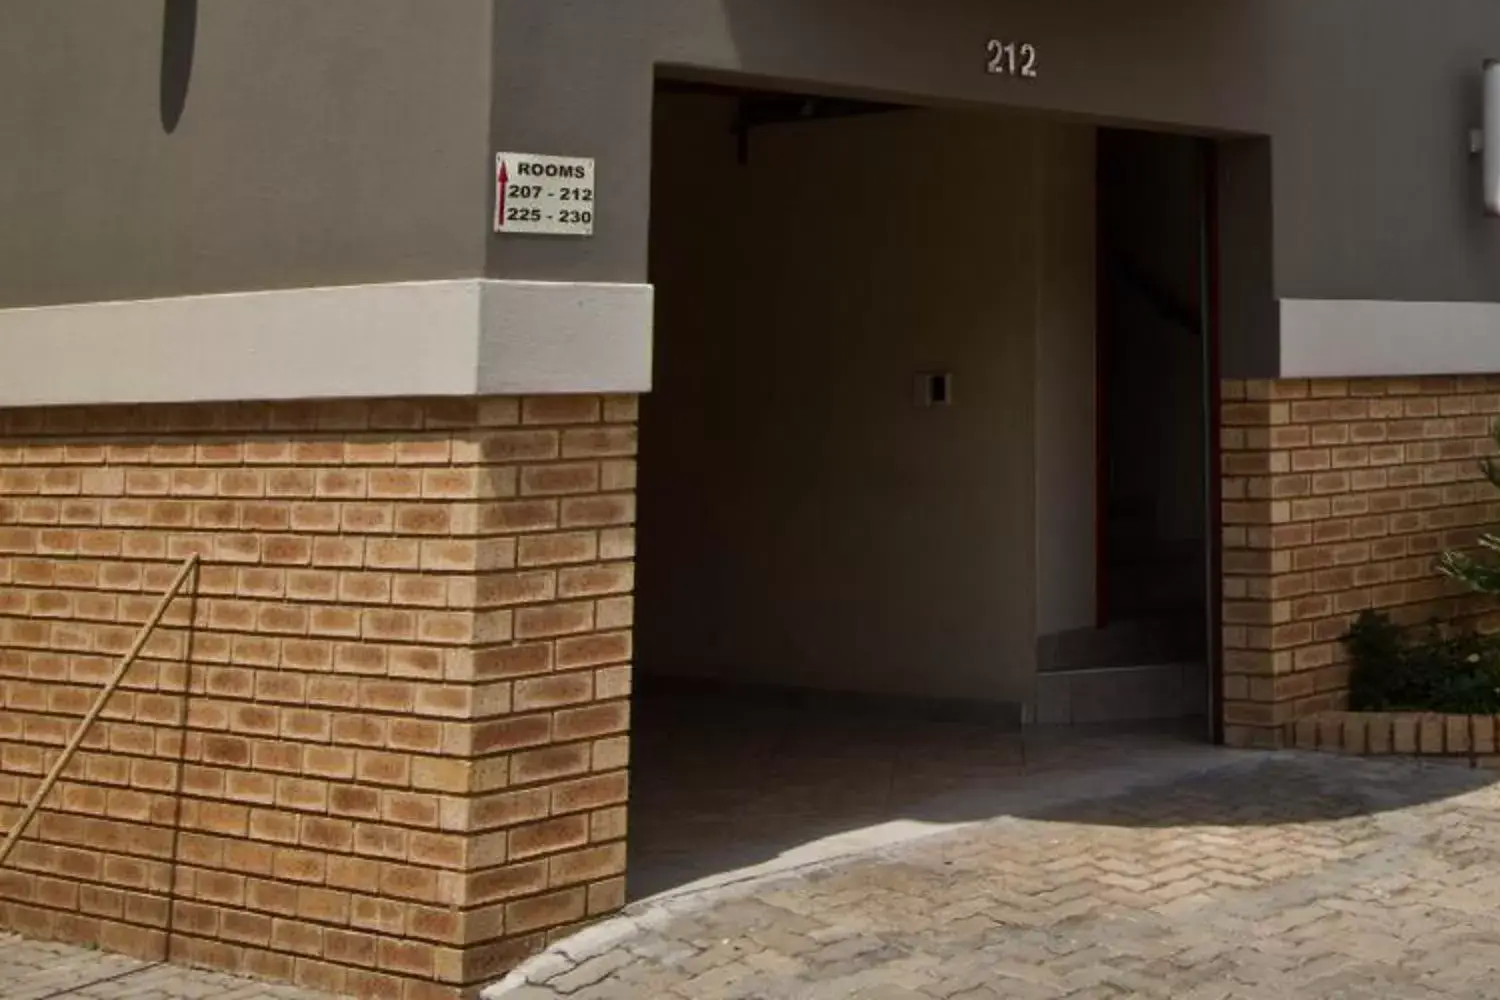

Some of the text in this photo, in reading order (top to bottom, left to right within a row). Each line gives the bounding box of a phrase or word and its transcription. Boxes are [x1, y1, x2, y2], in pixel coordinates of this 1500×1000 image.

[987, 39, 1036, 77] 212
[517, 162, 585, 179] ROOMS
[508, 185, 542, 199] 207
[560, 187, 592, 201] 212
[507, 207, 541, 221] 225
[559, 209, 591, 223] 230
